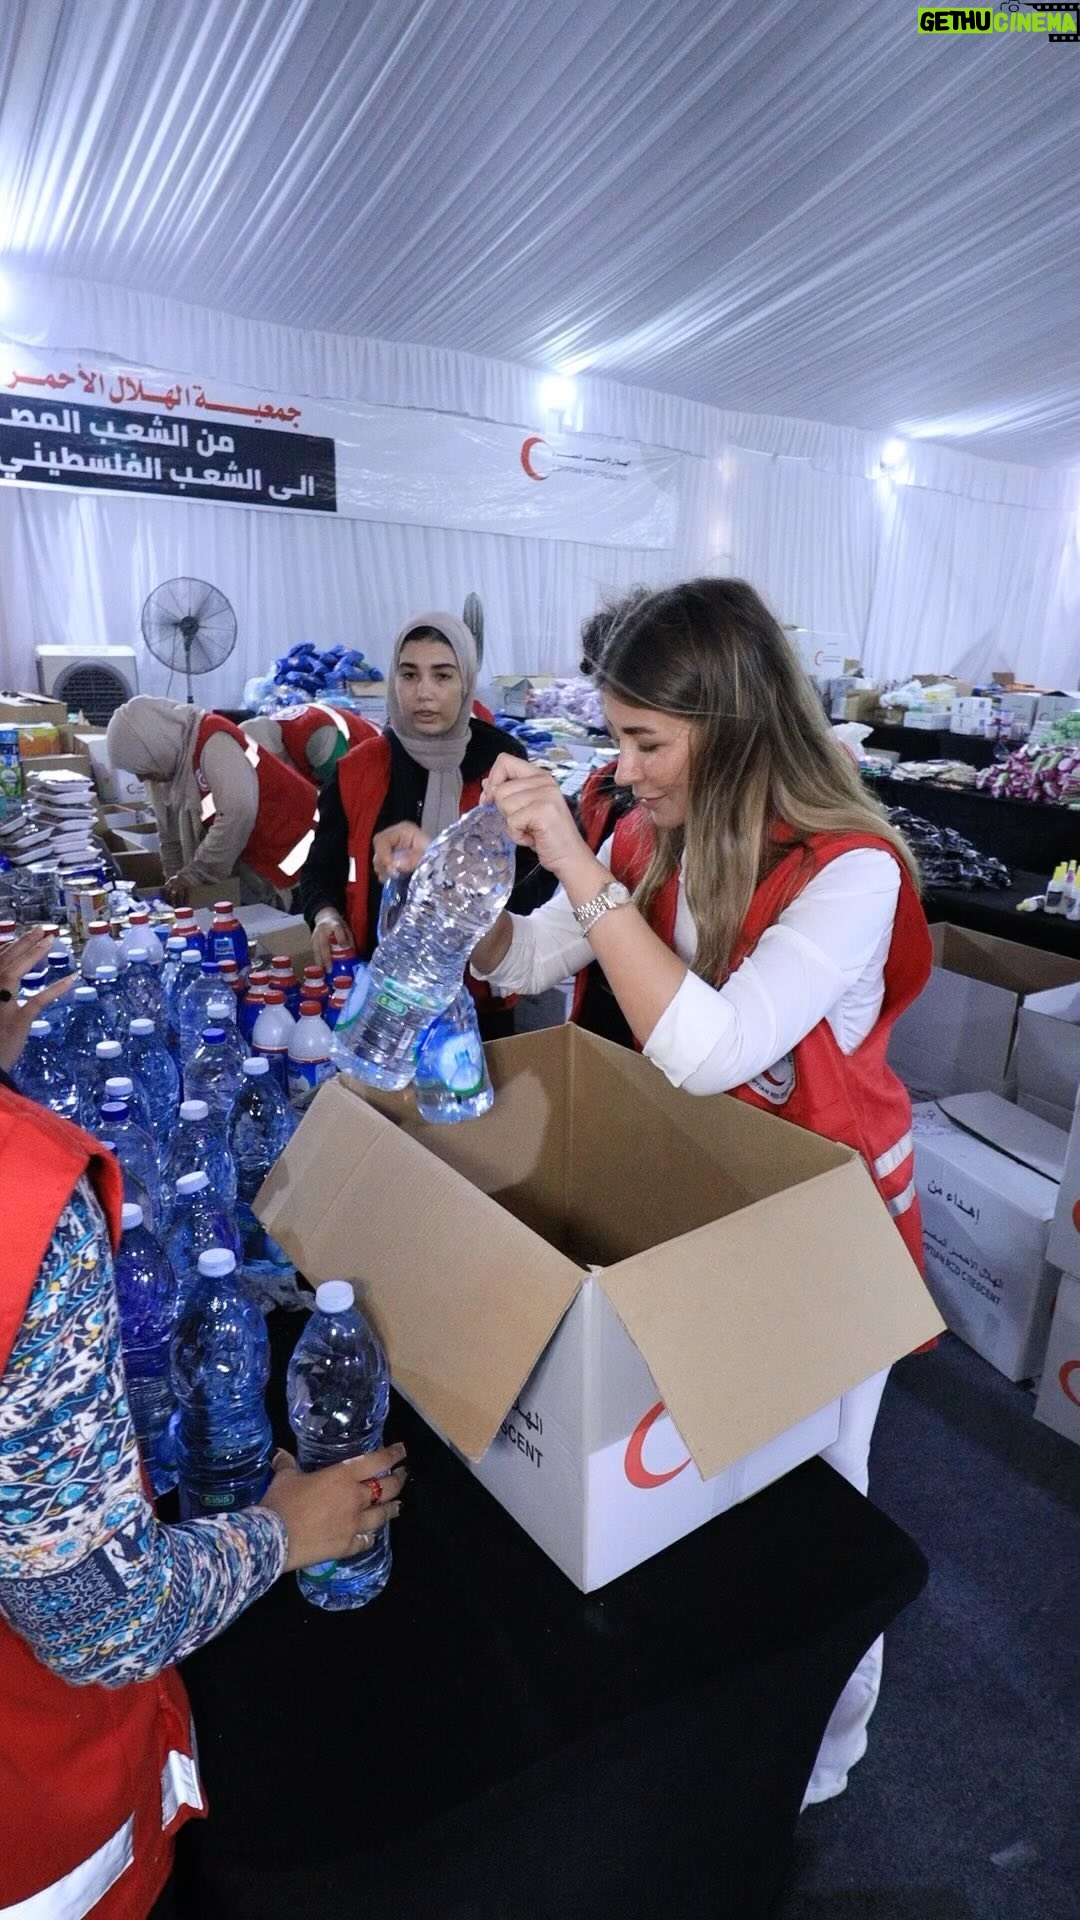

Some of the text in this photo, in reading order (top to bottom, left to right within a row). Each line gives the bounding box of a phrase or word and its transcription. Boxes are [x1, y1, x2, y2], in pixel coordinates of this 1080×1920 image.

[109, 374, 190, 411] الهلال
[0, 408, 235, 457] من الشعب المص
[0, 441, 316, 500] الى الشعب الفلسطيني
[927, 1180, 943, 1196] من
[501, 1420, 544, 1469] SCENT
